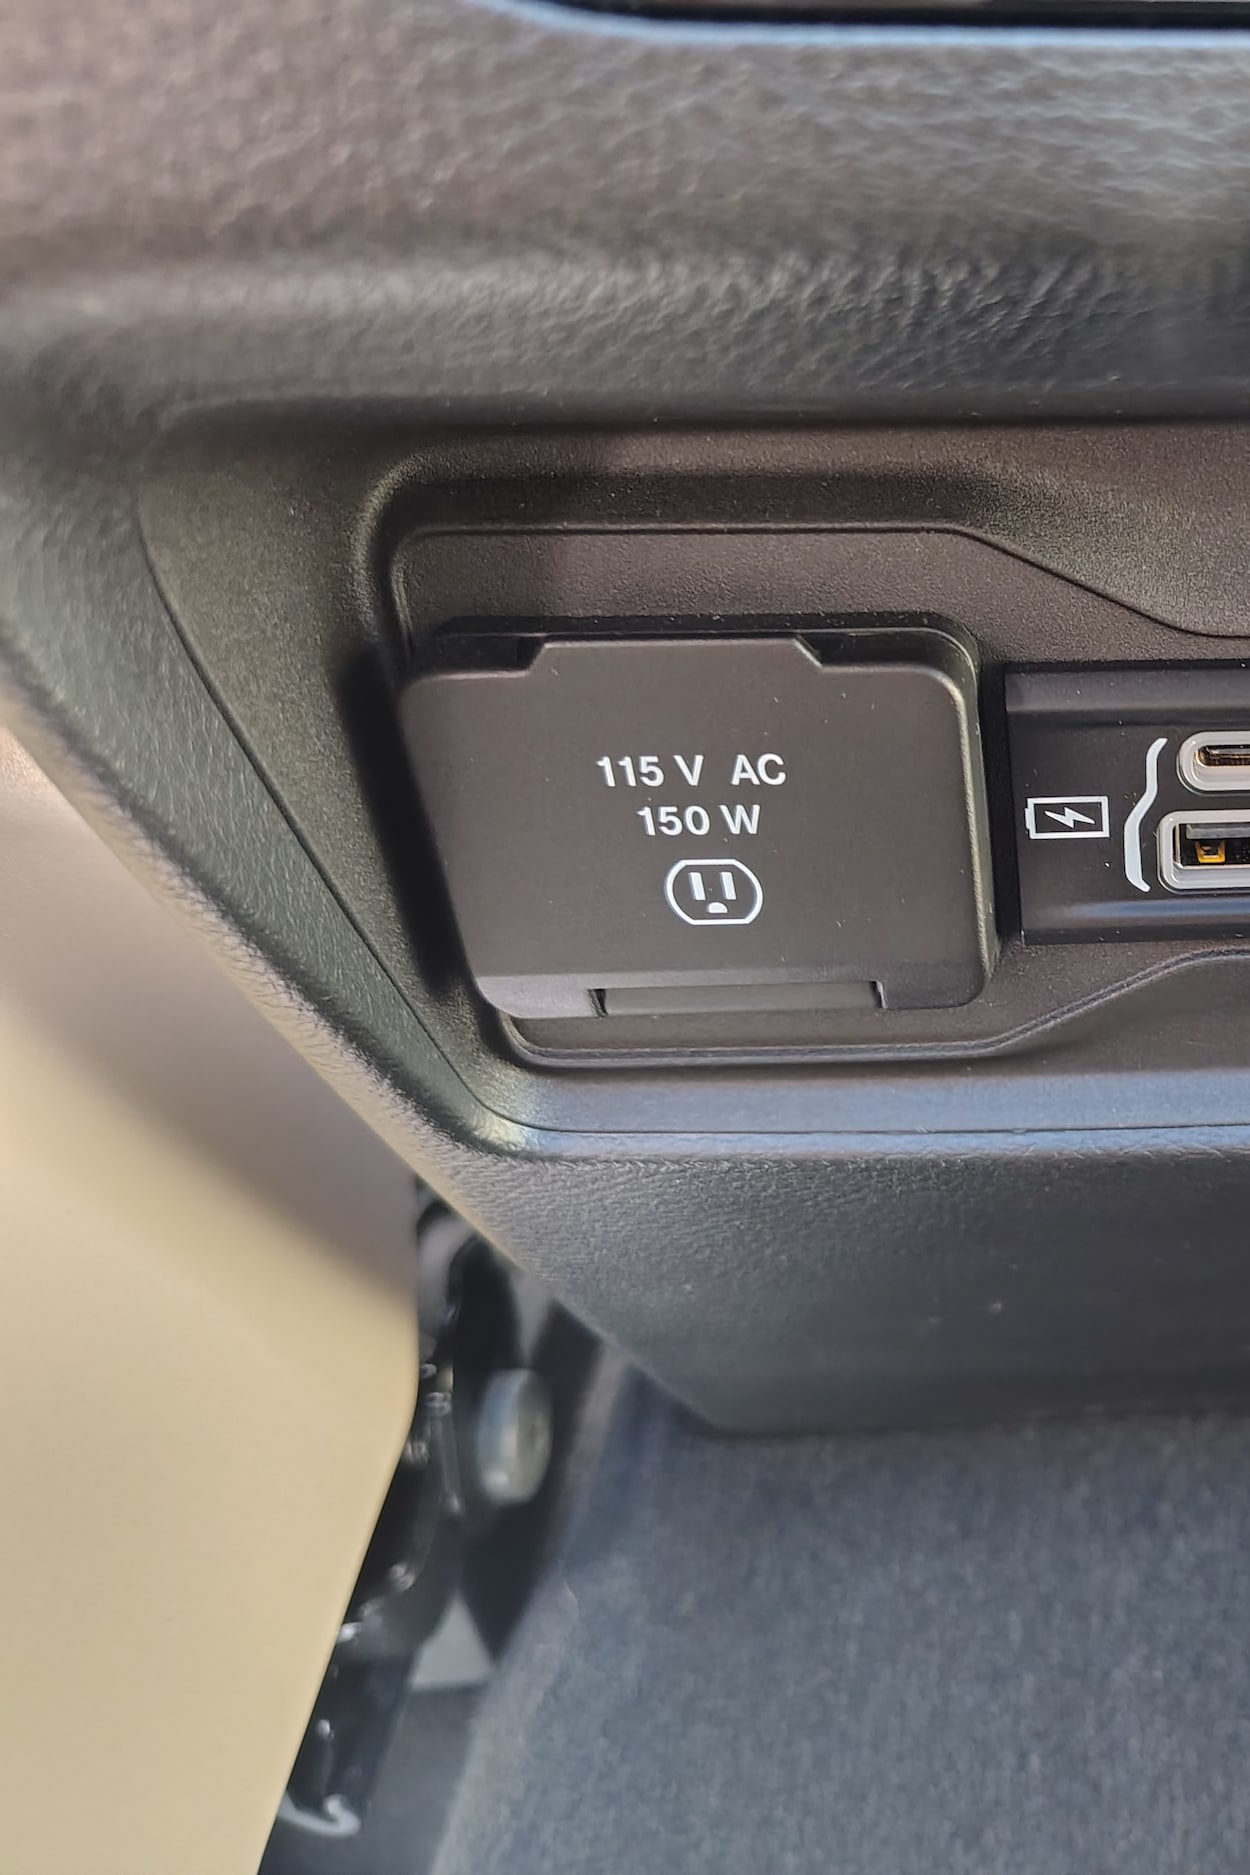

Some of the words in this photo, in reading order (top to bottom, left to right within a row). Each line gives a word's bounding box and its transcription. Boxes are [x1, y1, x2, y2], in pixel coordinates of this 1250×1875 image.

[596, 755, 664, 788] 115
[673, 754, 704, 787] V
[731, 752, 787, 786] AC
[636, 804, 710, 837] 150
[718, 803, 761, 835] W
